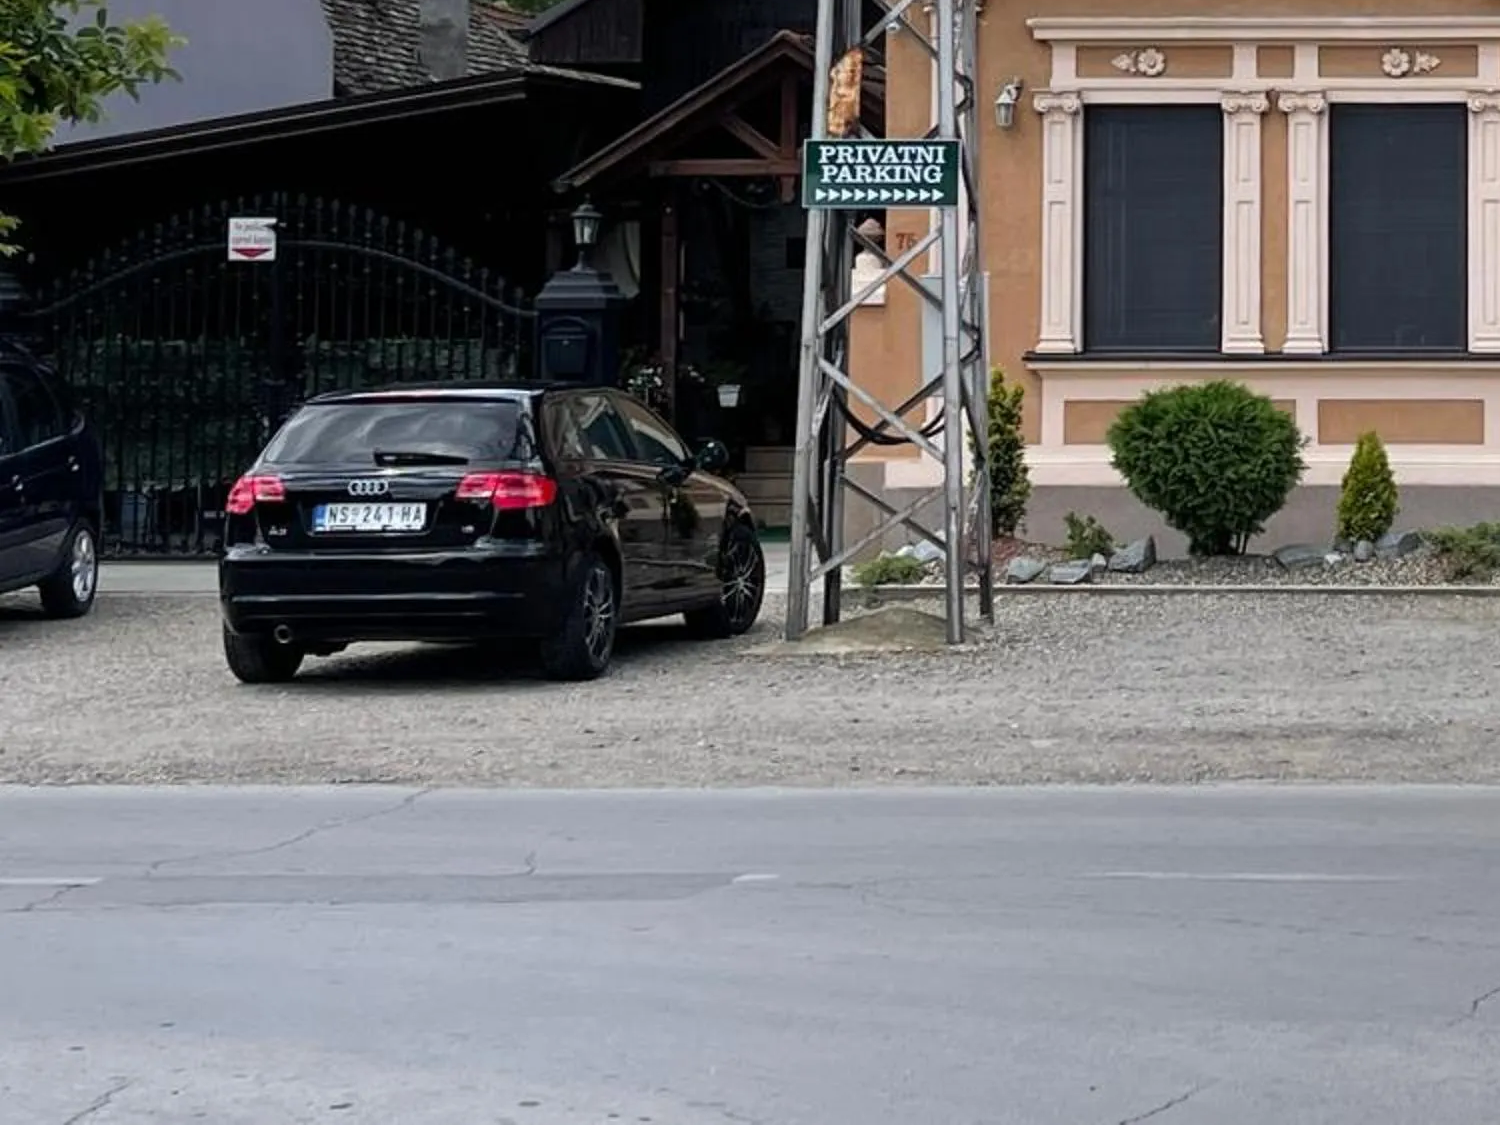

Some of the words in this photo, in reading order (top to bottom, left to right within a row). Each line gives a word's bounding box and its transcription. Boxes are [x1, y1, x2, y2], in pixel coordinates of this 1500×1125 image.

[818, 146, 947, 164] PRIVATNI
[820, 165, 944, 184] PARKING
[328, 506, 349, 524] NS
